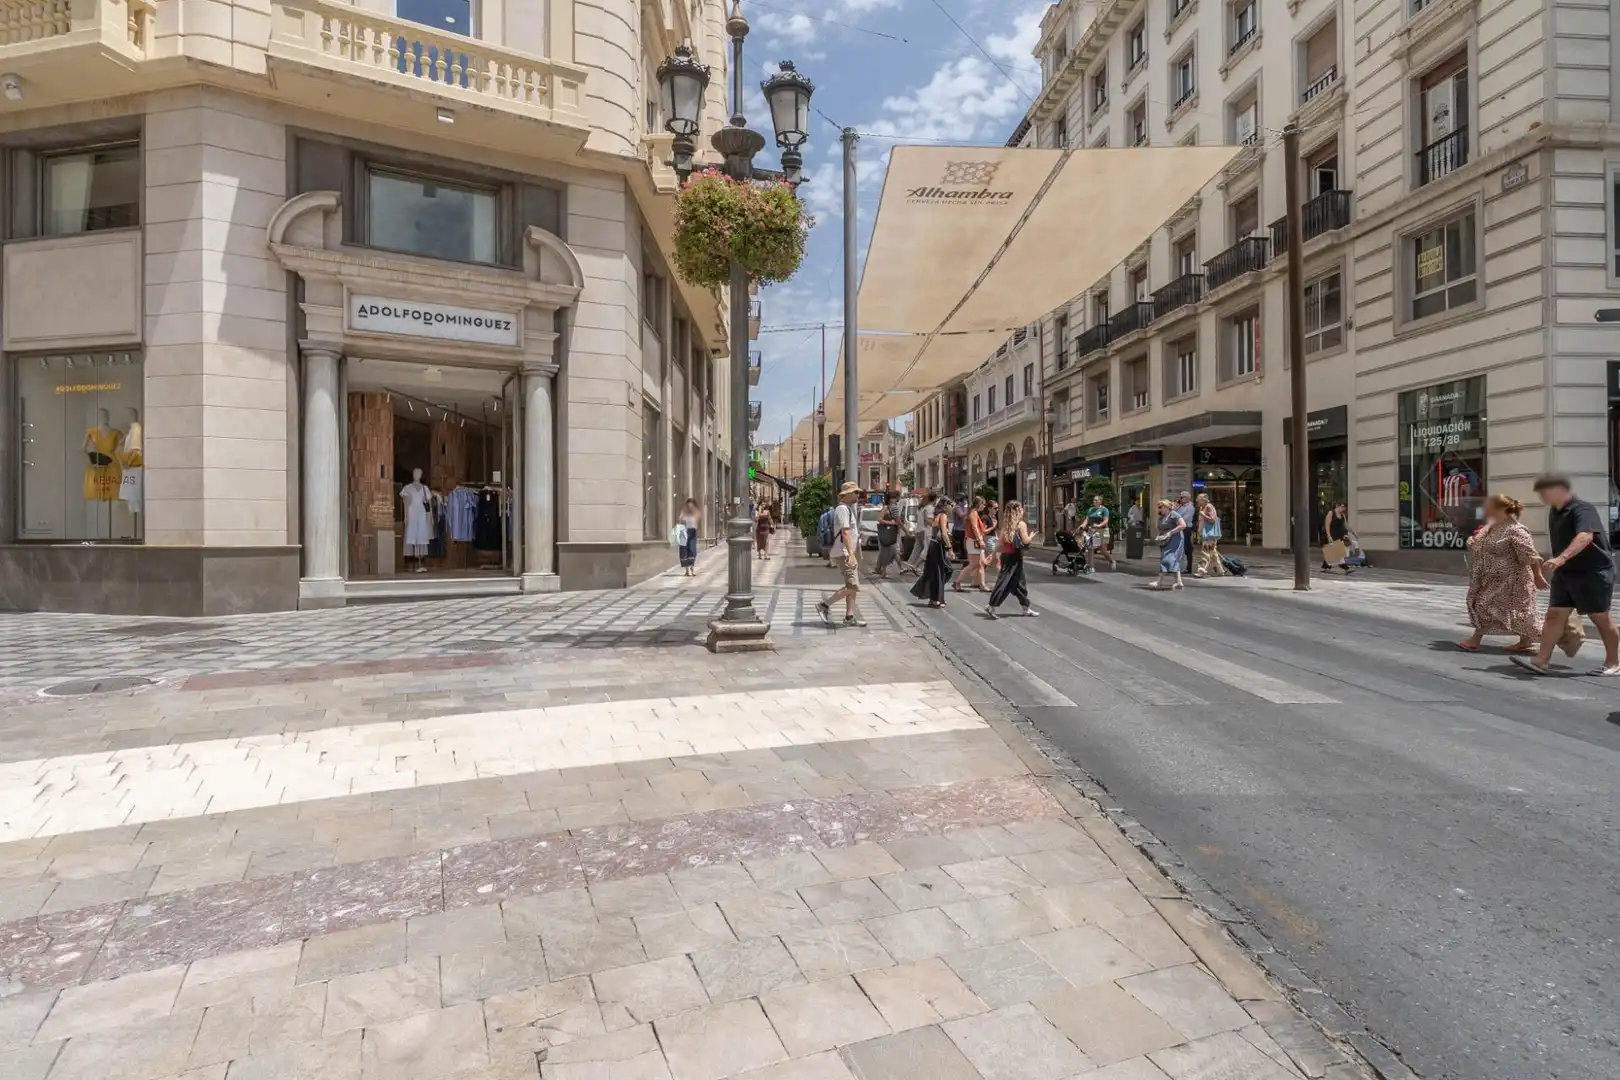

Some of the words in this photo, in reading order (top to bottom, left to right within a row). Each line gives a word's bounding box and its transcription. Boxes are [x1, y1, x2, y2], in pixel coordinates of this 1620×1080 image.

[906, 187, 1014, 199] Alhambra
[358, 304, 511, 331] ADOLFODOMINGUEZ
[1414, 419, 1471, 438] LIQUIDACIÓN
[93, 475, 136, 485] REBAJAS
[1415, 531, 1464, 548] -60%
